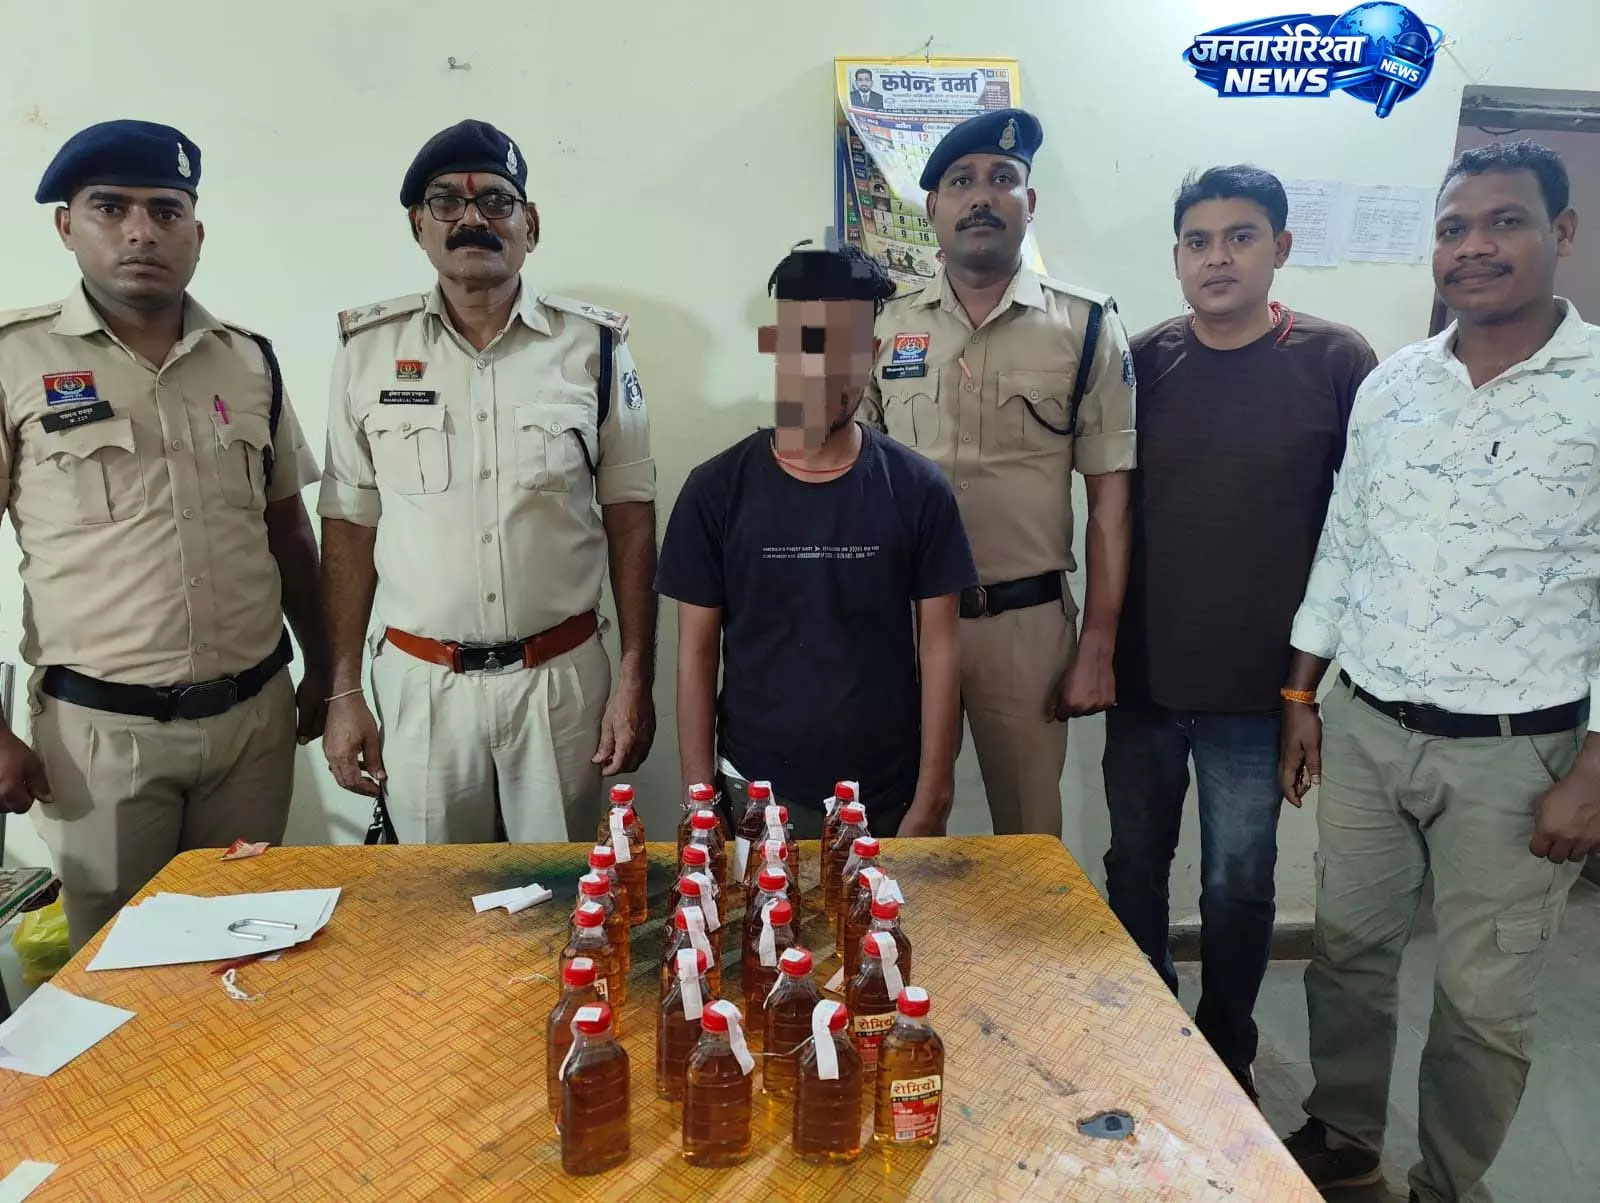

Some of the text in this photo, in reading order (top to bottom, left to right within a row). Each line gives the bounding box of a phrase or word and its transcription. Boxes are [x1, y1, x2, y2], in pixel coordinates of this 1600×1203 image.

[880, 70, 978, 93] रूपेन्द्र वर्मा
[917, 133, 929, 142] 12
[899, 215, 905, 225] 8
[918, 217, 928, 228] 15
[882, 225, 930, 241] 2 9 16
[894, 1079, 936, 1094] रोमियो
